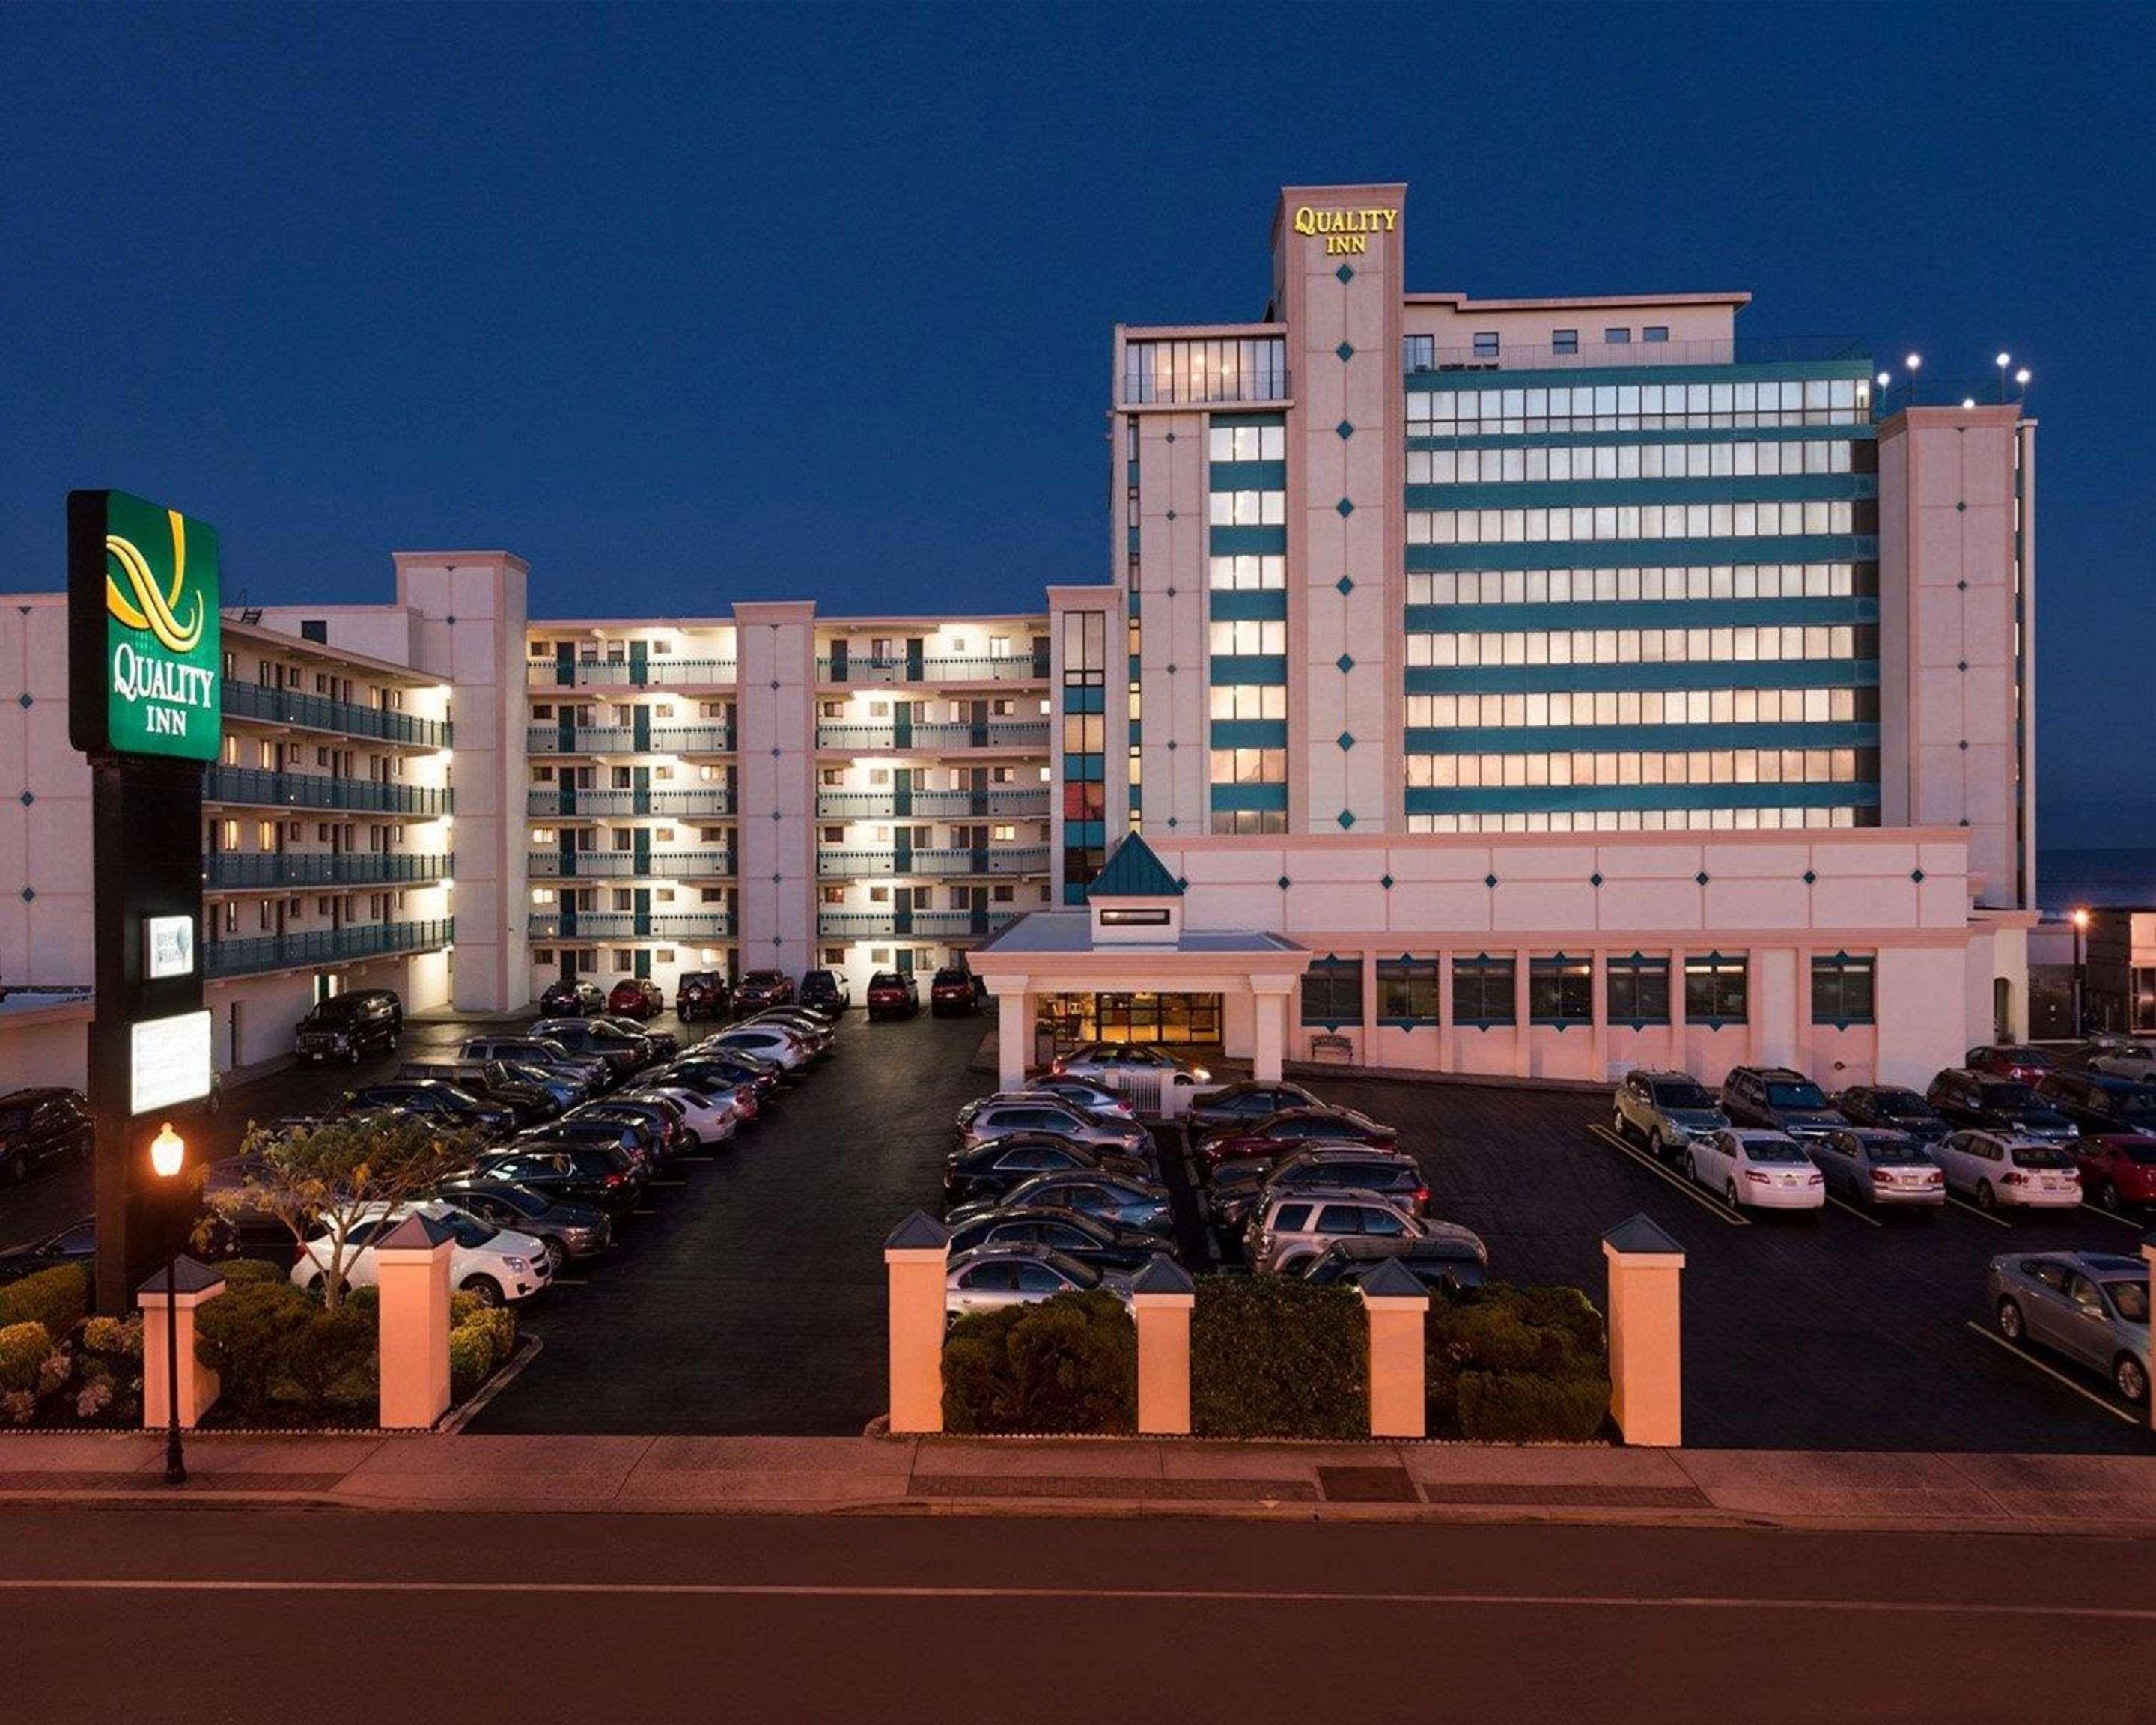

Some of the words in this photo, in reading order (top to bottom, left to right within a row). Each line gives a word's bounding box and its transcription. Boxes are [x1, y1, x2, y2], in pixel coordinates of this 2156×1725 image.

[1294, 207, 1398, 236] QUALITY
[1326, 236, 1365, 255] INN
[114, 642, 215, 708] QUALITY
[145, 705, 188, 737] INN
